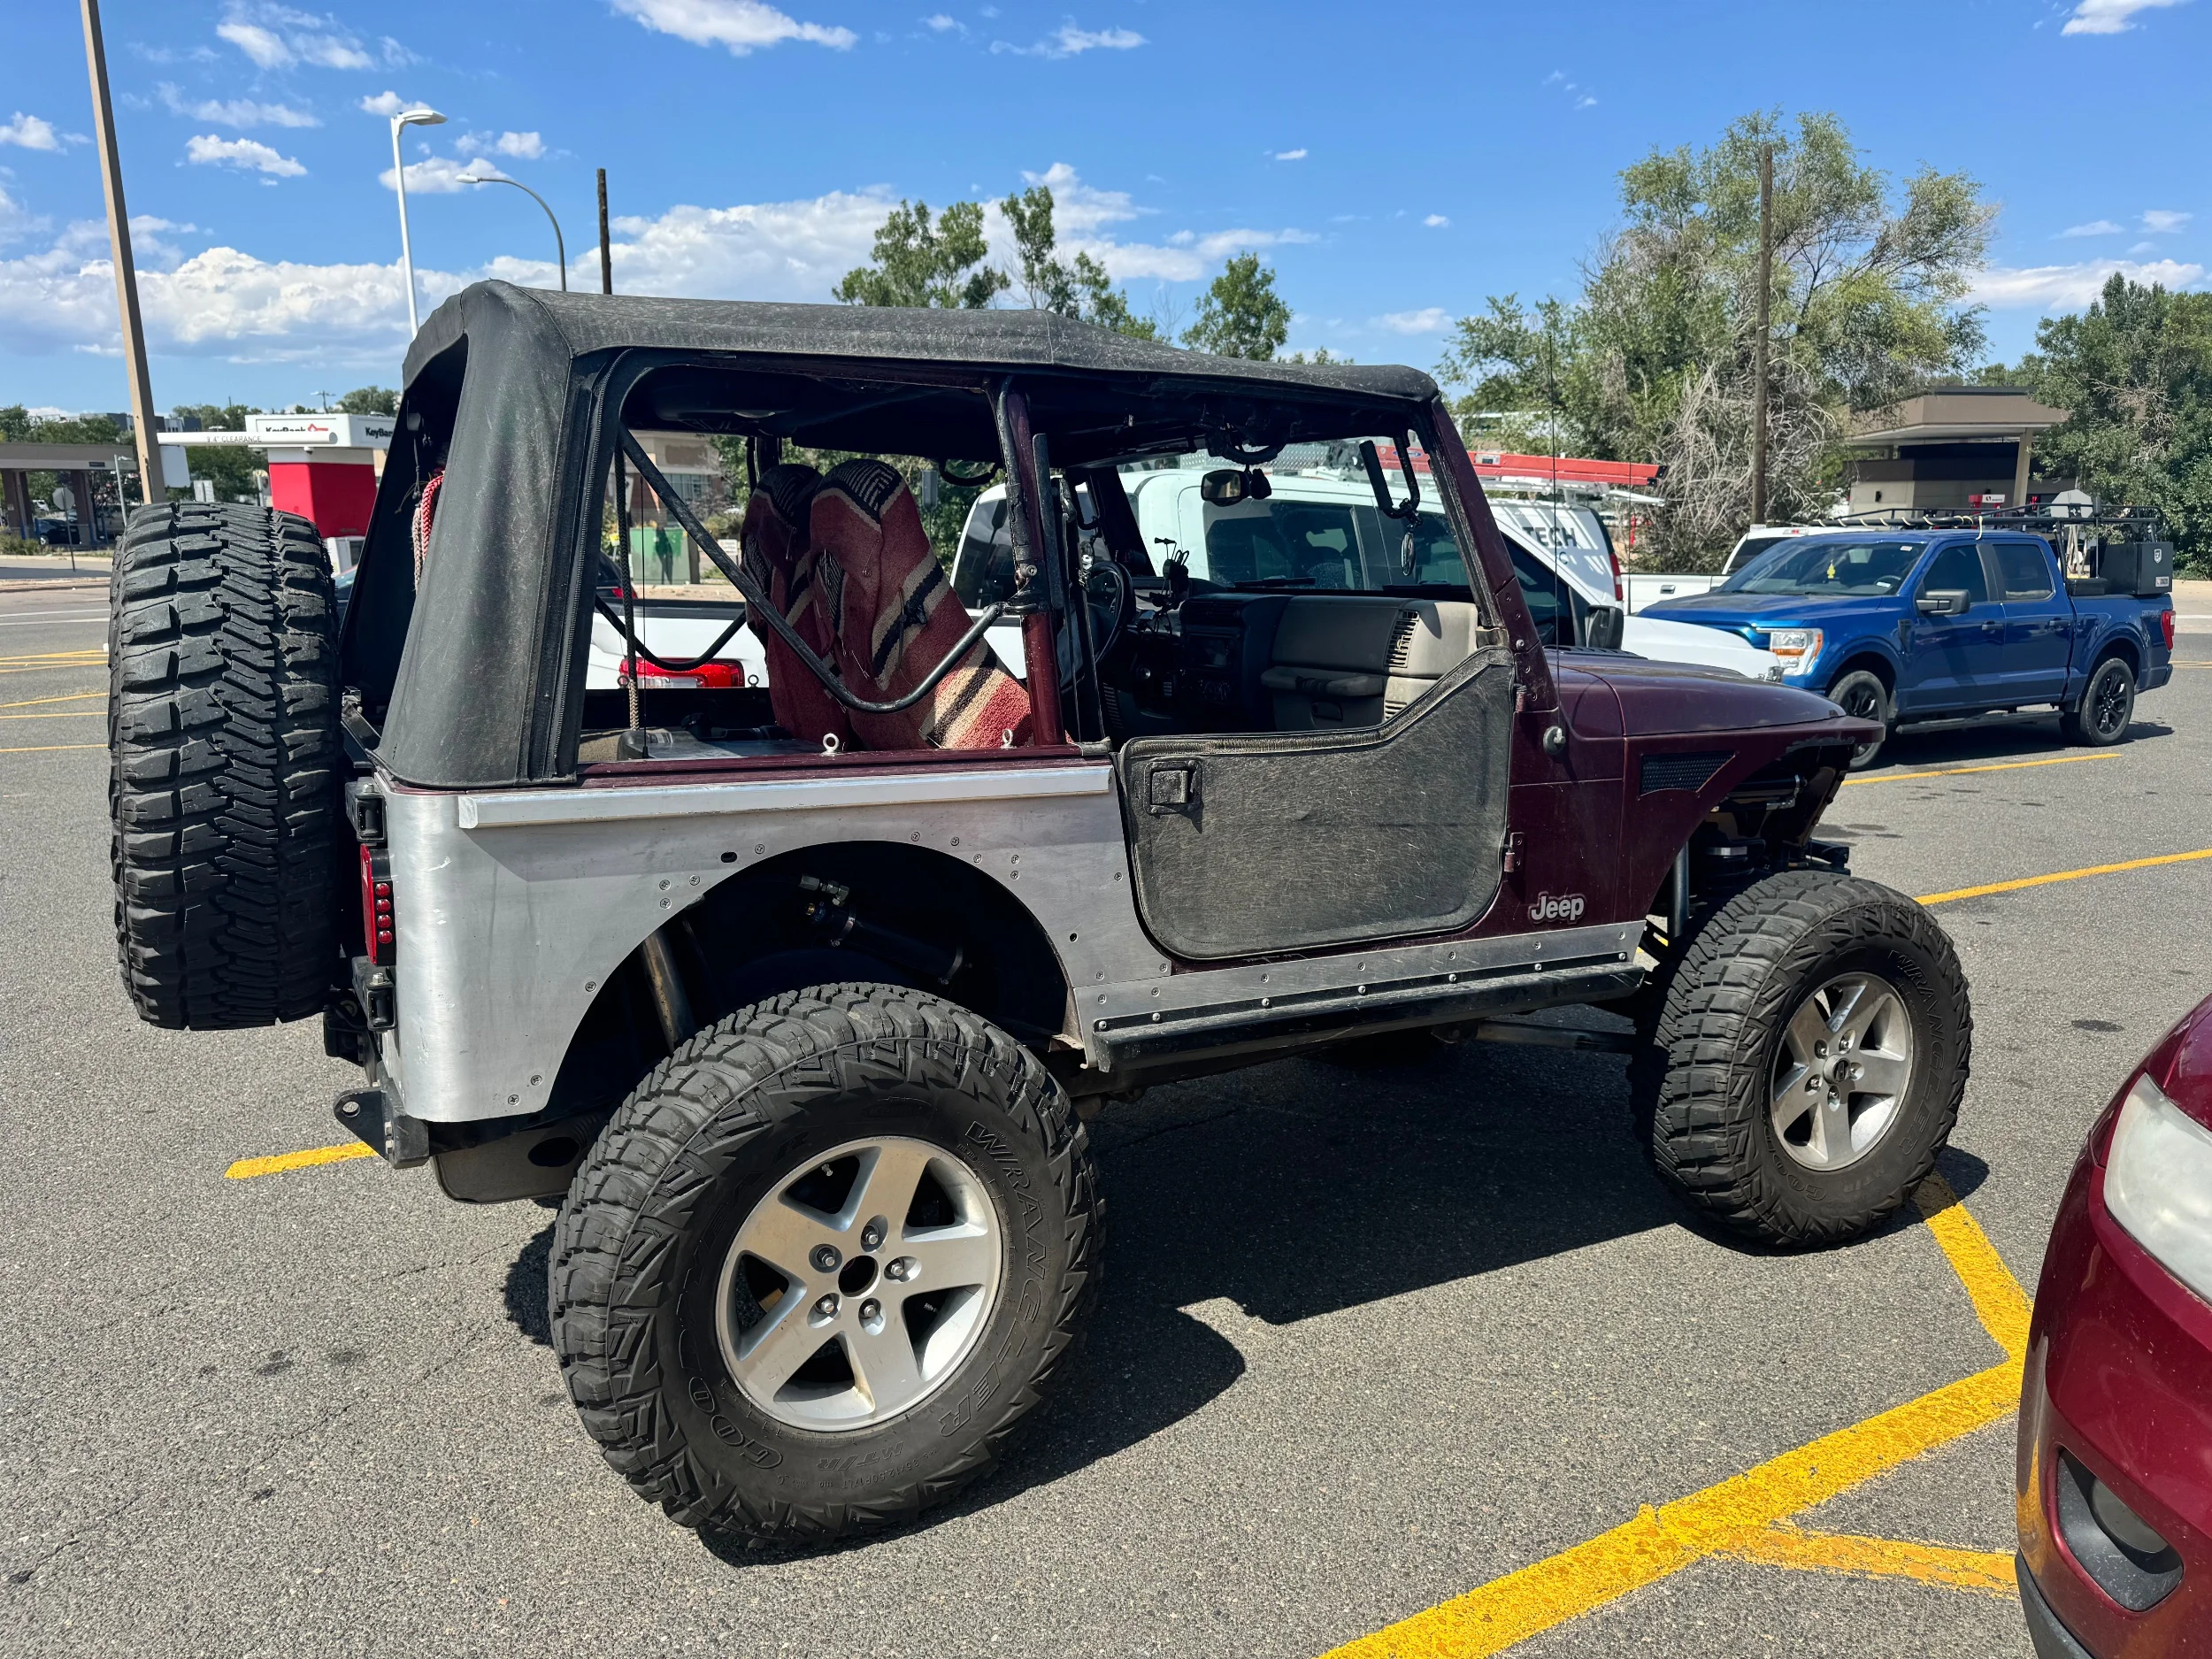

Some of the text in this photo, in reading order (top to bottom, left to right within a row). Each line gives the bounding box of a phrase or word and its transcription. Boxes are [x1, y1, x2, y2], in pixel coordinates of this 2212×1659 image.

[365, 426, 393, 439] KeyBan
[1522, 526, 1578, 548] TECH
[1531, 895, 1585, 921] Jeep
[936, 1120, 1048, 1438] WRANGLER
[816, 1440, 904, 1472] MT/R
